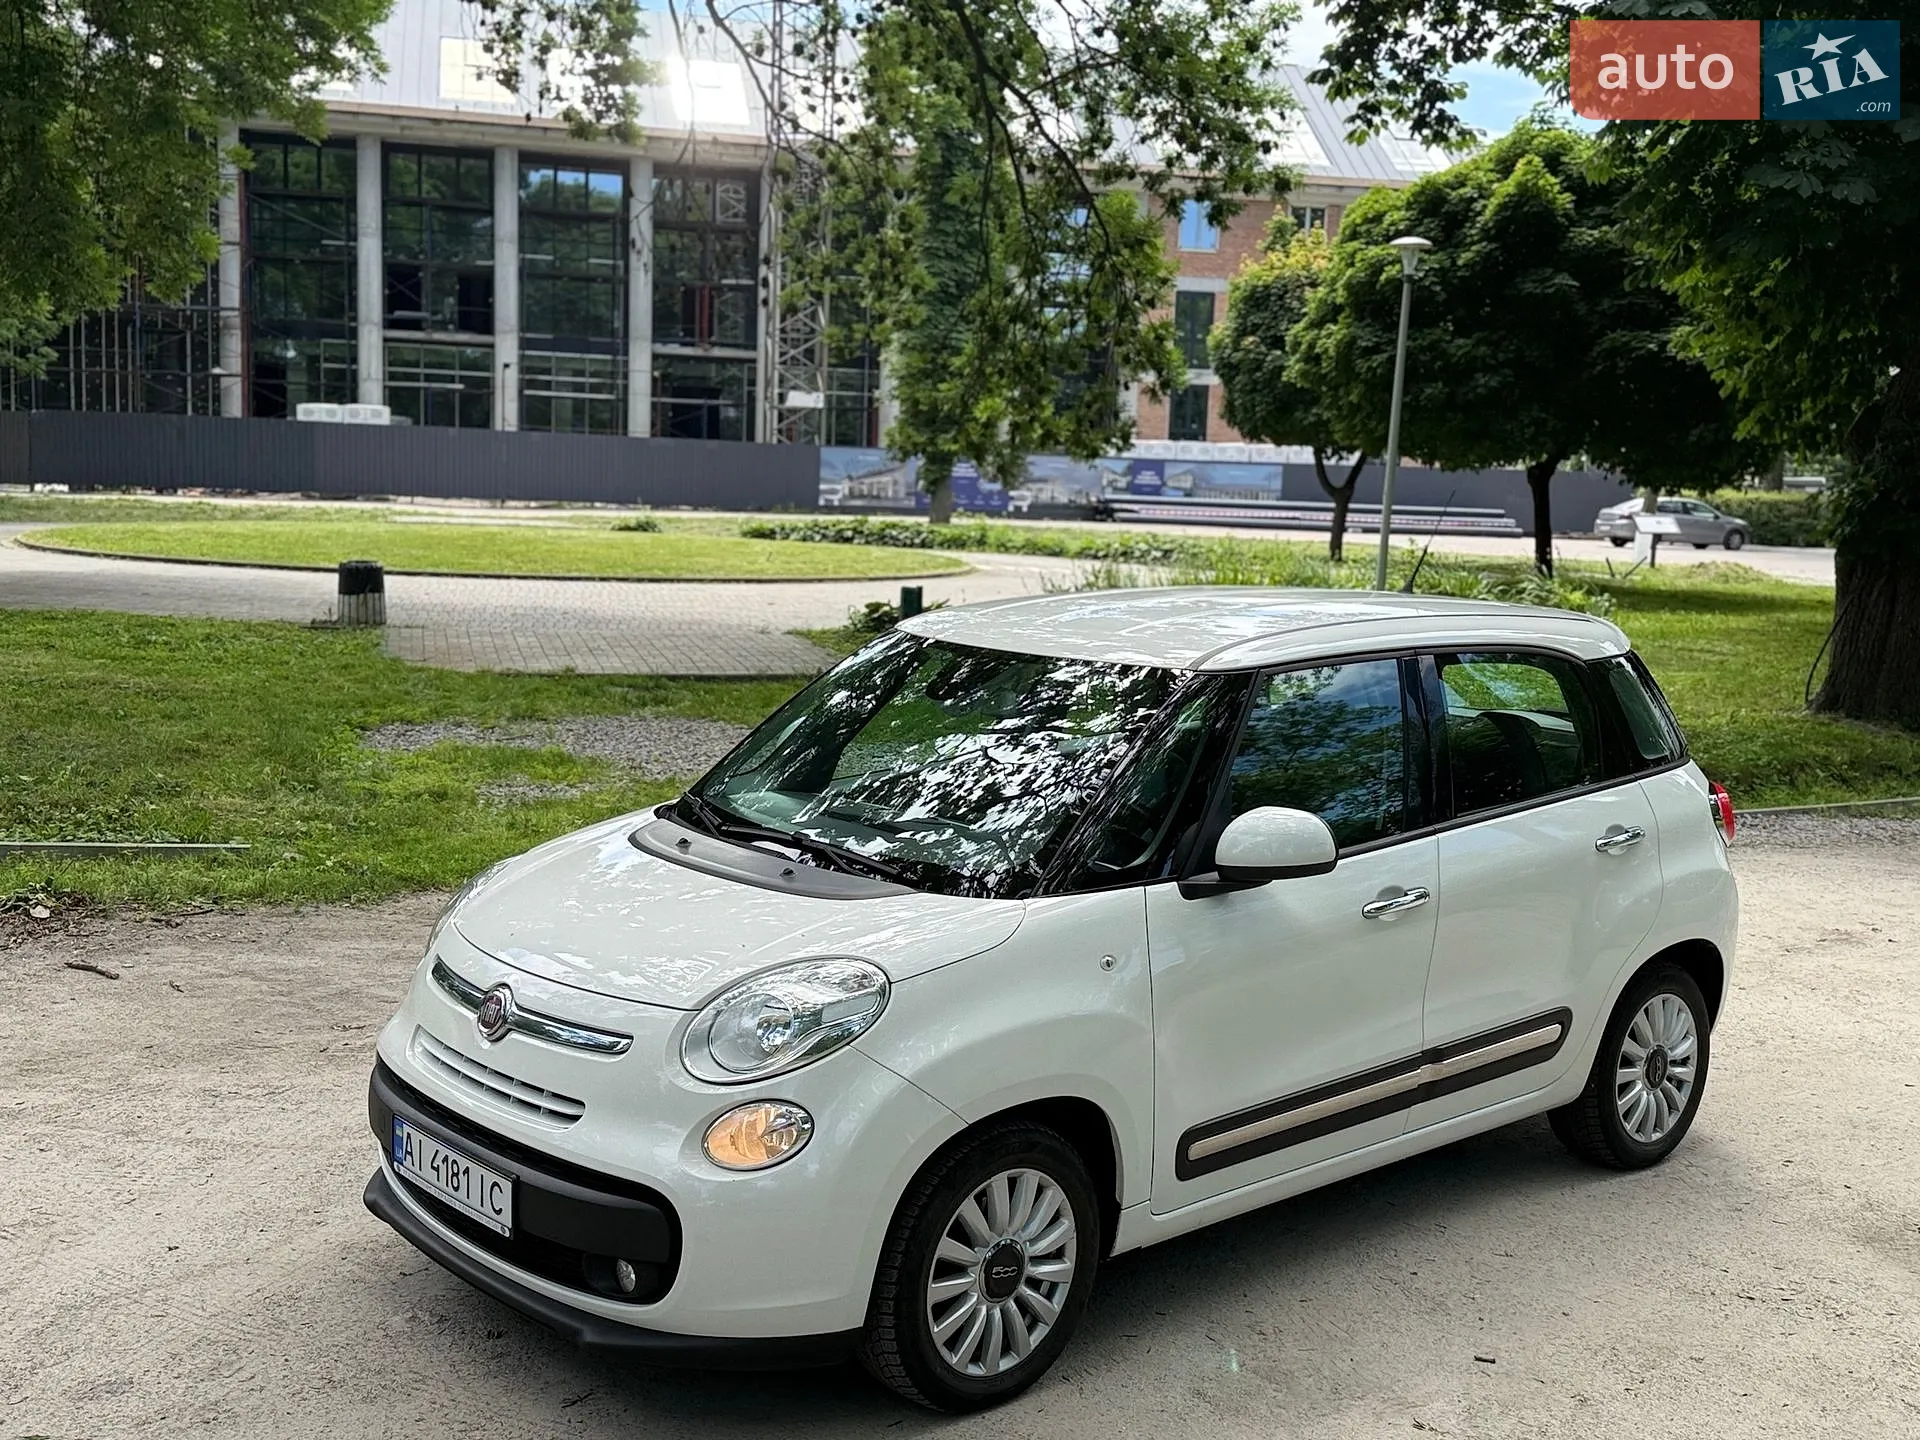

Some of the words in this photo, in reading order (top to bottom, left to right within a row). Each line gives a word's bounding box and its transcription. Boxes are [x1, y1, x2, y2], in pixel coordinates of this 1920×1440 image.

[404, 1131, 422, 1171] AI
[430, 1149, 470, 1200] 4181
[480, 1173, 503, 1216] IC
[992, 1266, 1018, 1278] 500
